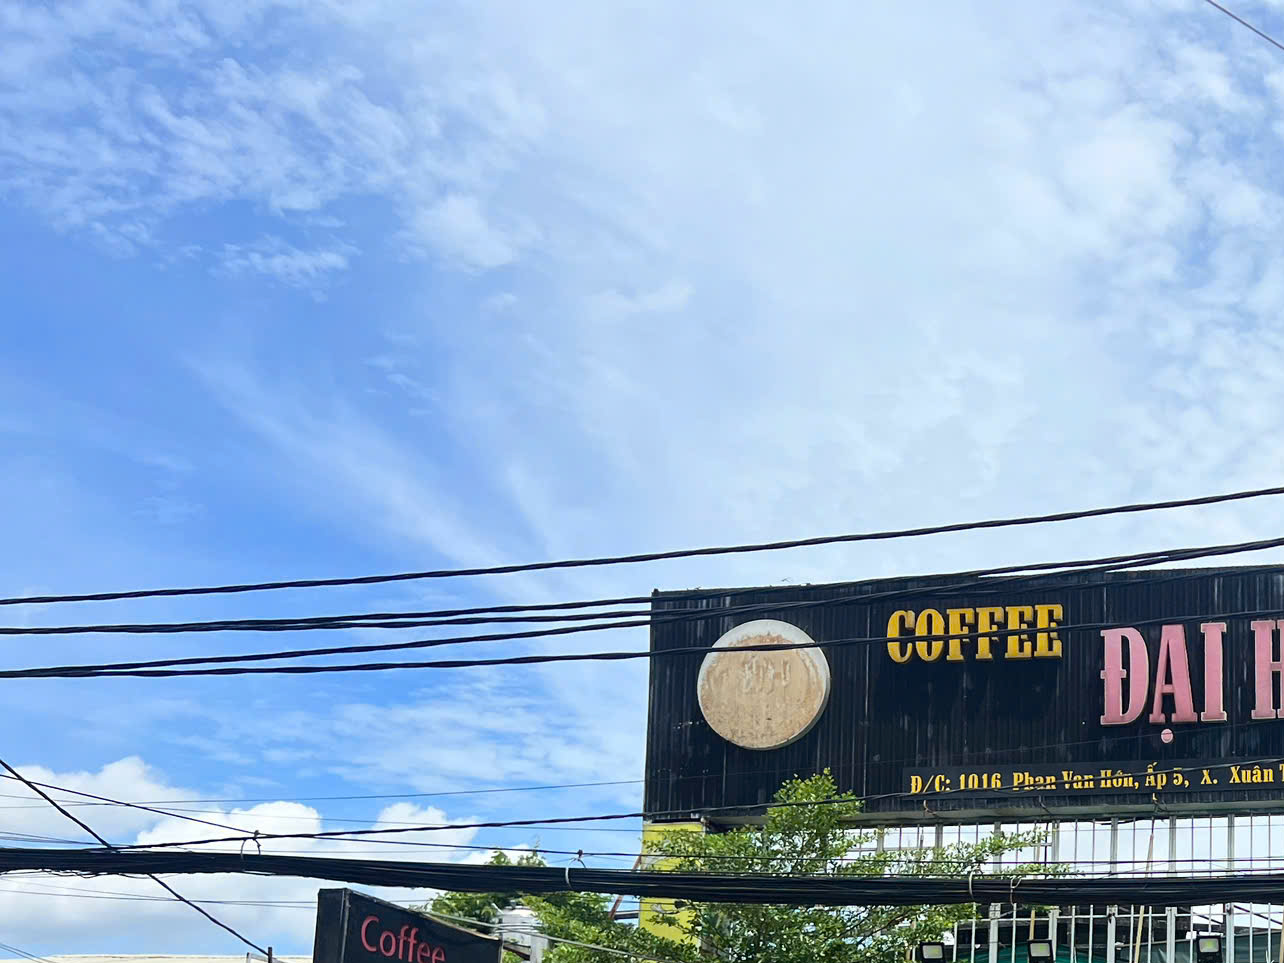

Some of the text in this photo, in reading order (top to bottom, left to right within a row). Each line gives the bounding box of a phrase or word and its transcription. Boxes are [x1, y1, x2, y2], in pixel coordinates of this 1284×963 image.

[887, 603, 1064, 663] COFFEE
[1100, 622, 1227, 744] ĐẠI
[959, 772, 1002, 791] 1016
[1013, 771, 1057, 791] Phan
[1229, 765, 1274, 783] Xuân
